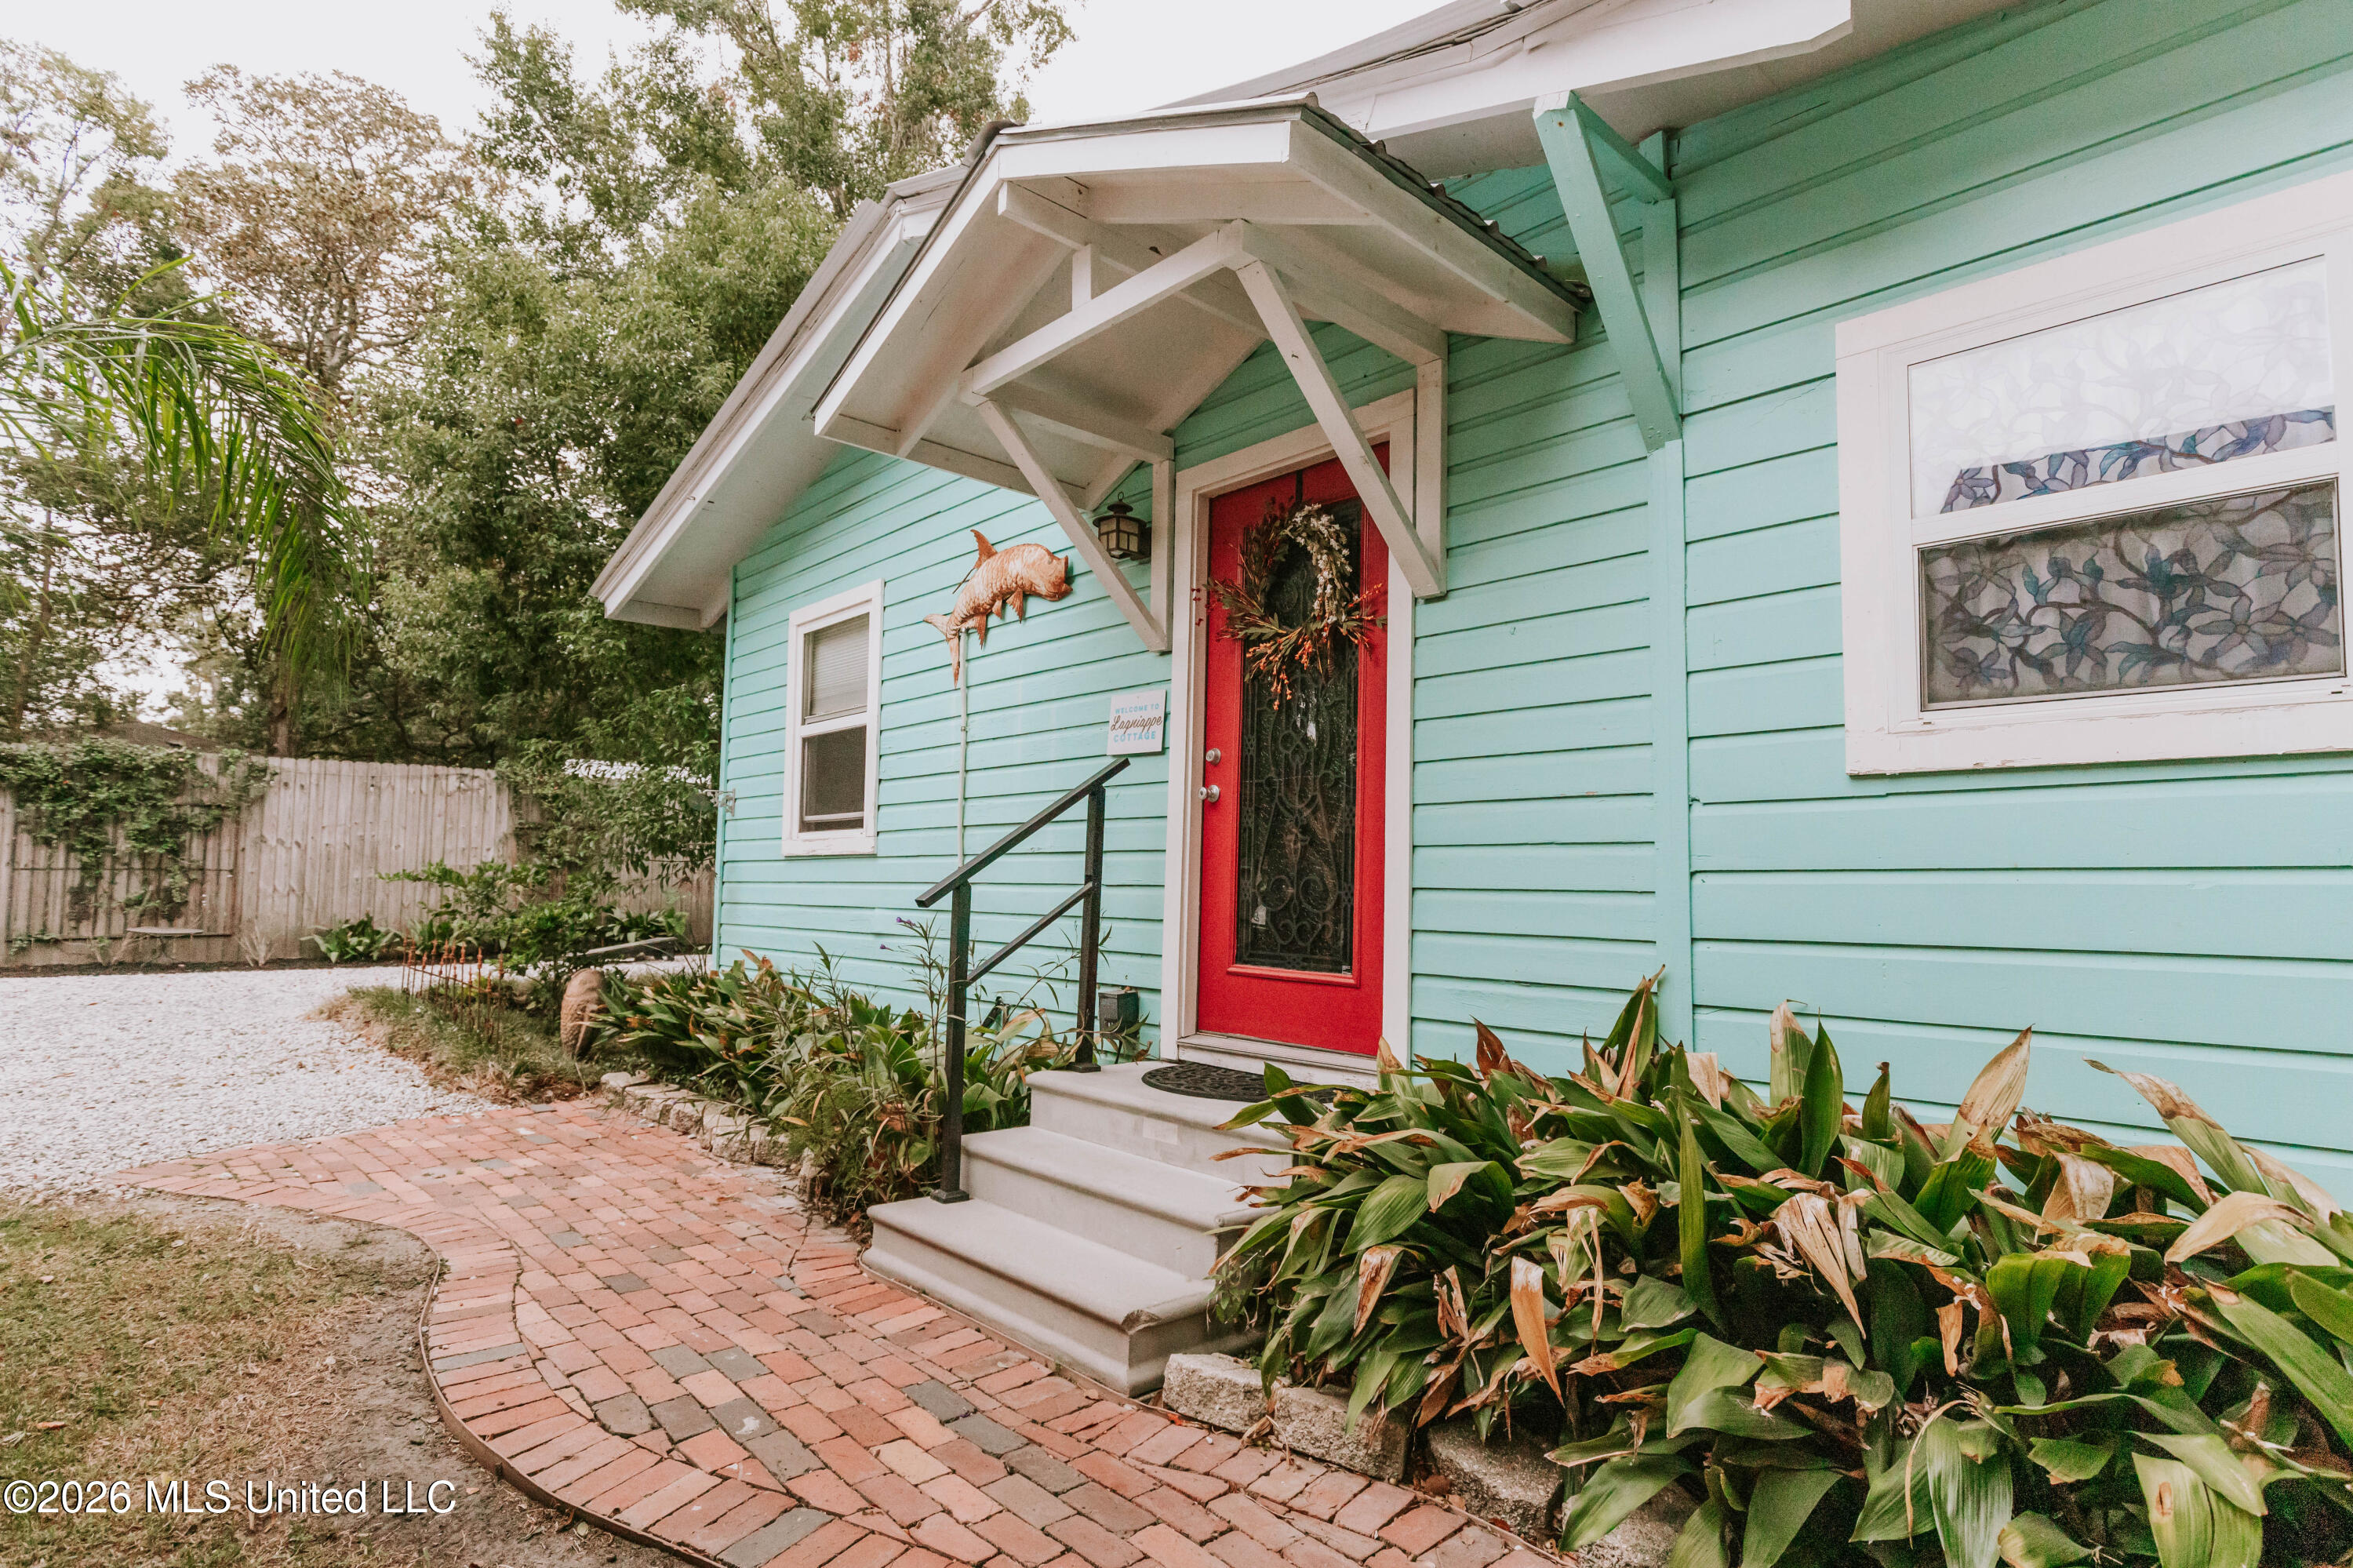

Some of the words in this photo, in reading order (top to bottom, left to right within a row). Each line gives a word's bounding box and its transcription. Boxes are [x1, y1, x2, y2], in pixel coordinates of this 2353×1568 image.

[1115, 704, 1147, 715] WELCOME
[1111, 715, 1163, 734] Lagniappe
[1114, 731, 1156, 742] COTTAGE
